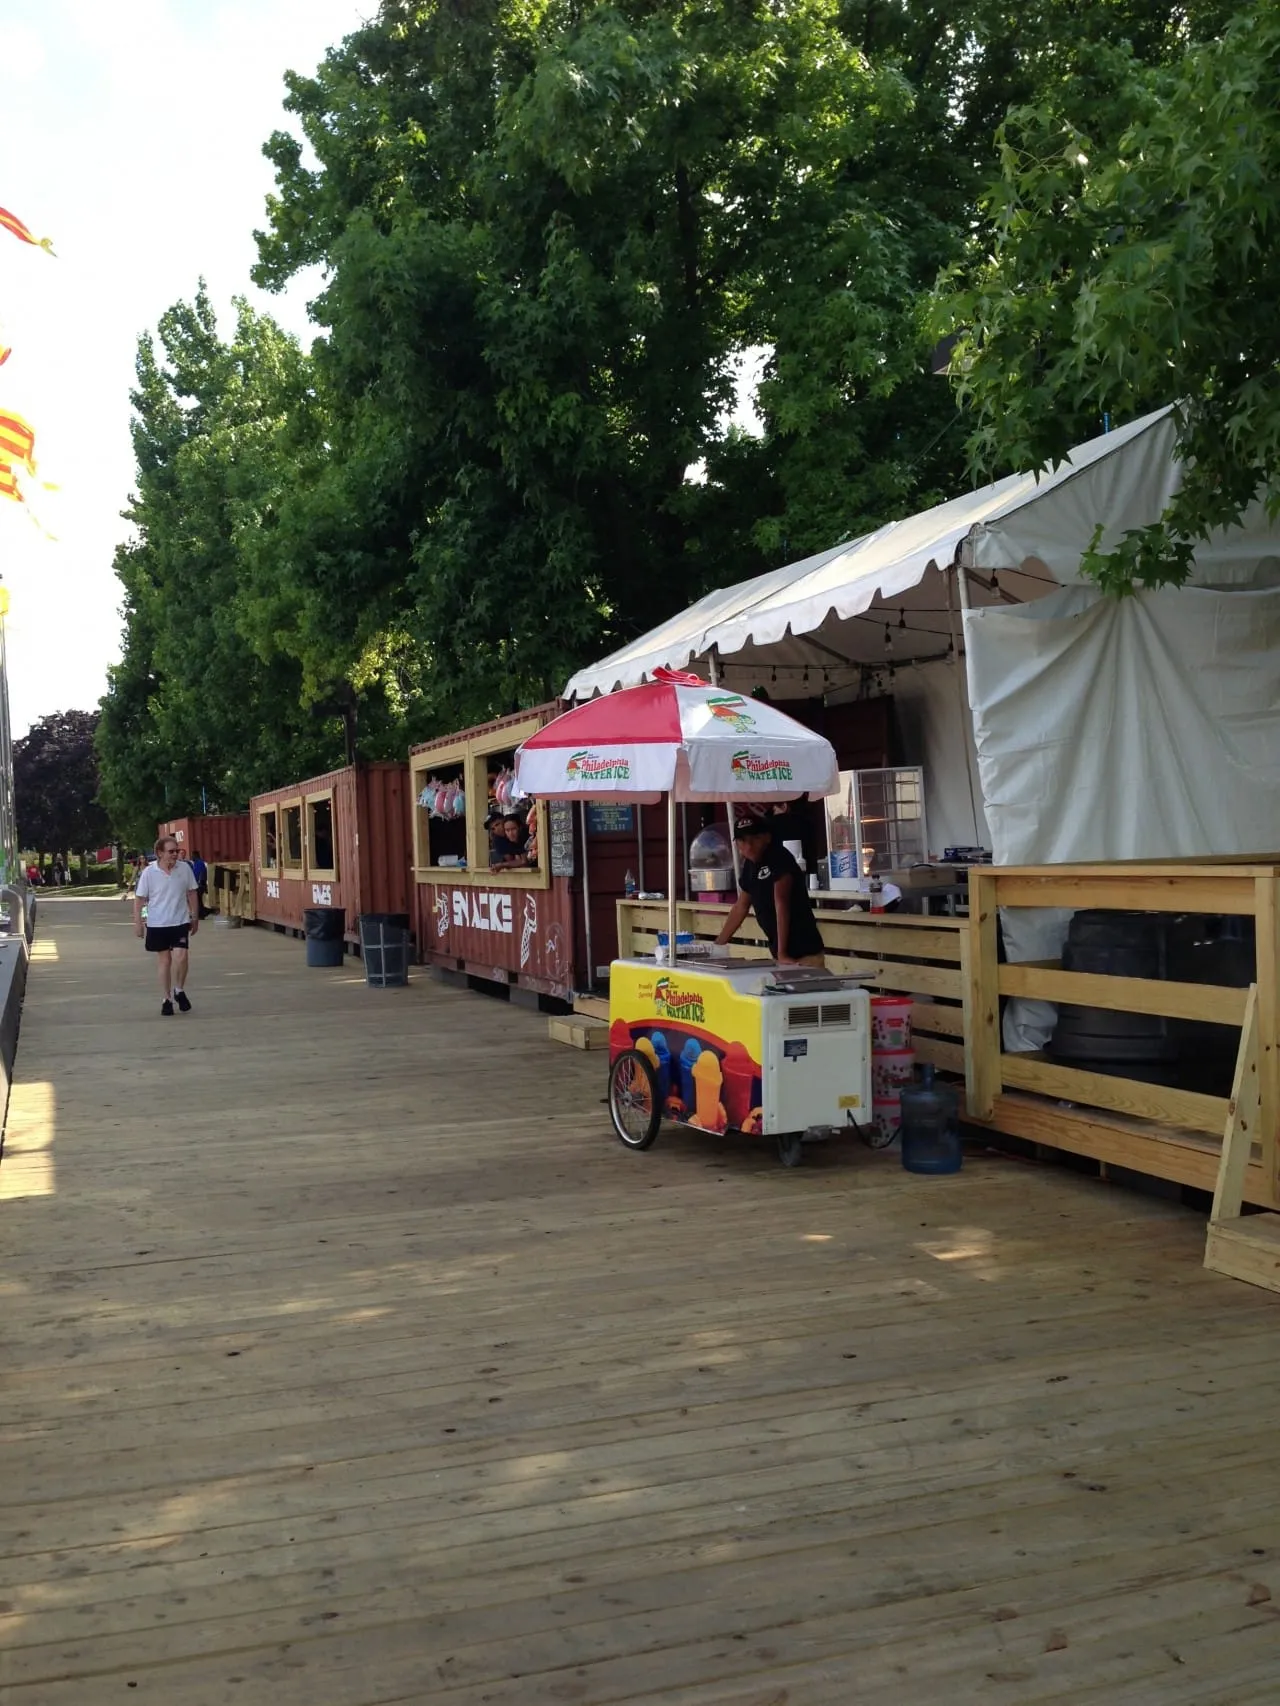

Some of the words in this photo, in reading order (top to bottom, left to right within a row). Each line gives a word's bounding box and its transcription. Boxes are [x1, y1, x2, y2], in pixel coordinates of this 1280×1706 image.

[581, 759, 629, 771] Philadelphia
[746, 759, 790, 771] Philadelphia
[580, 767, 612, 780] WATER
[613, 766, 630, 780] ICE
[748, 768, 777, 780] WATER
[778, 767, 793, 780] ICE
[666, 989, 703, 1006] Philadelphia
[667, 1004, 692, 1019] WATER
[692, 1003, 705, 1023] ICE
